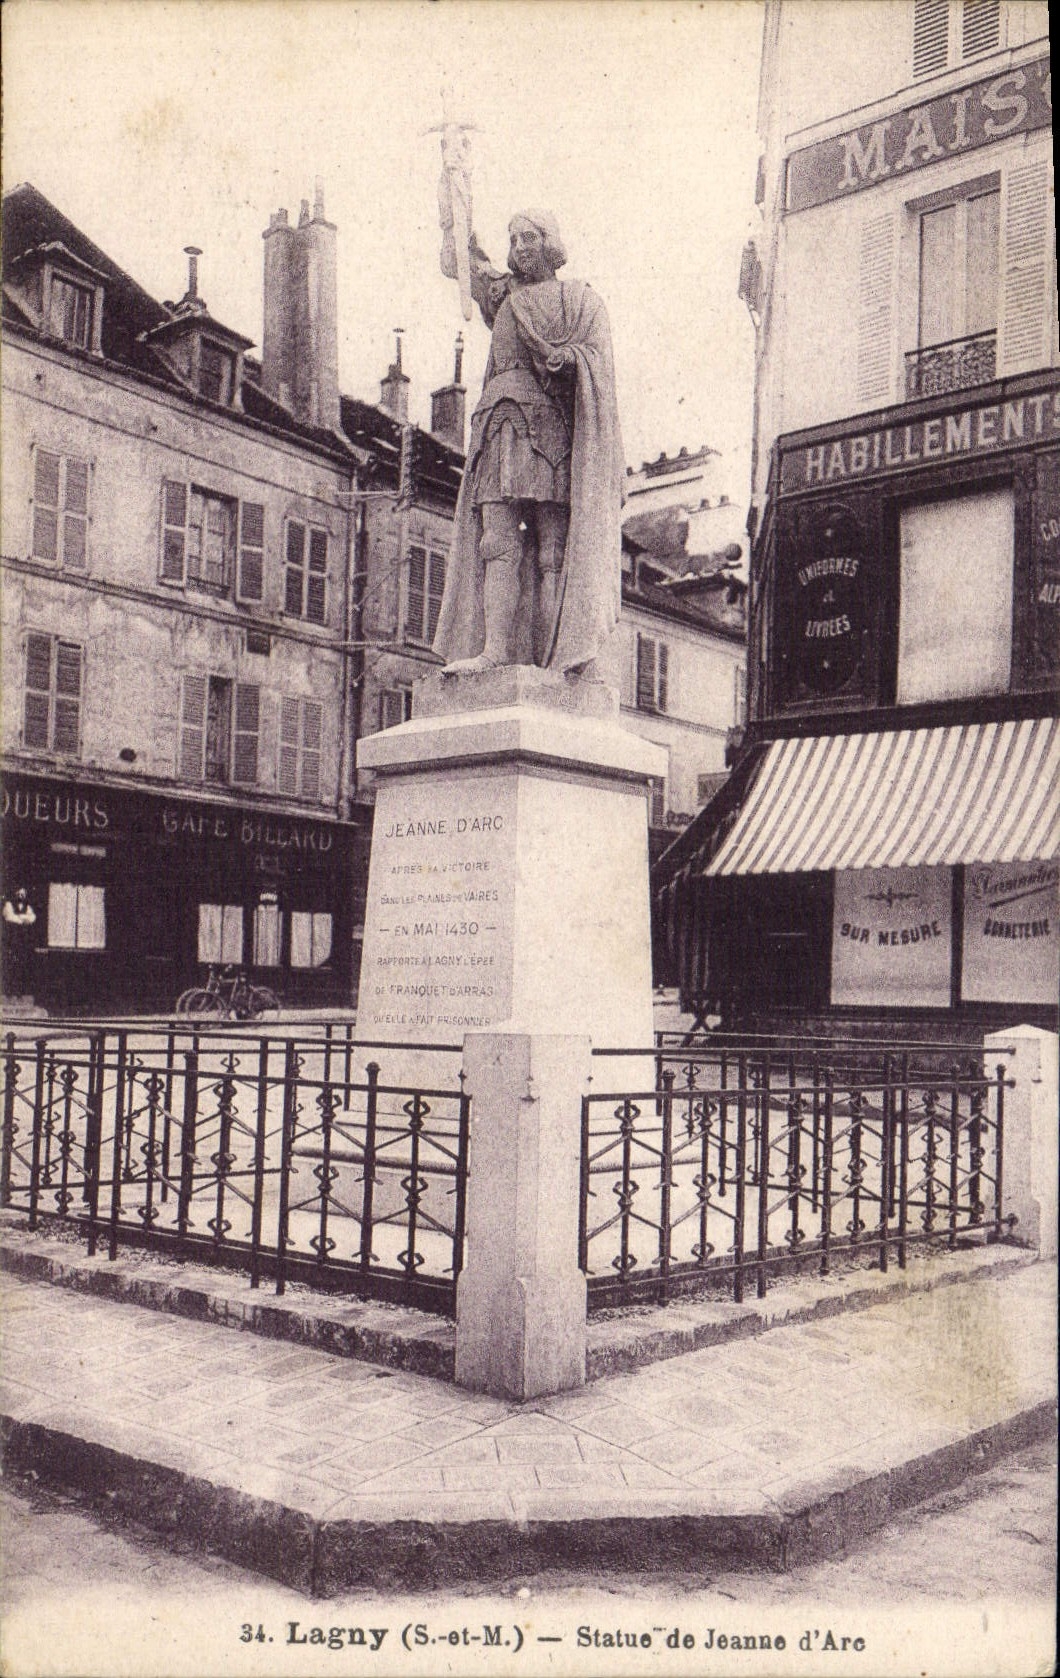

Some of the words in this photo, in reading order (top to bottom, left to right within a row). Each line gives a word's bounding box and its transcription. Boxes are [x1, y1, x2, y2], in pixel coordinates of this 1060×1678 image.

[837, 71, 1052, 190] MAIS
[241, 815, 333, 852] BILLARD
[385, 820, 448, 838] JEANNE
[457, 815, 504, 833] D'ARC
[442, 861, 491, 873] VICTOIRE
[464, 889, 500, 902] VAIRES
[394, 925, 409, 936] EN
[413, 922, 438, 936] MAI
[445, 921, 479, 936] 1430
[840, 922, 870, 945] SUR
[877, 920, 942, 947] MESURE
[429, 955, 463, 966] LAGNY
[375, 986, 386, 996] DE
[389, 985, 448, 997] FRANQUET
[437, 1015, 492, 1027] PRISONNIER
